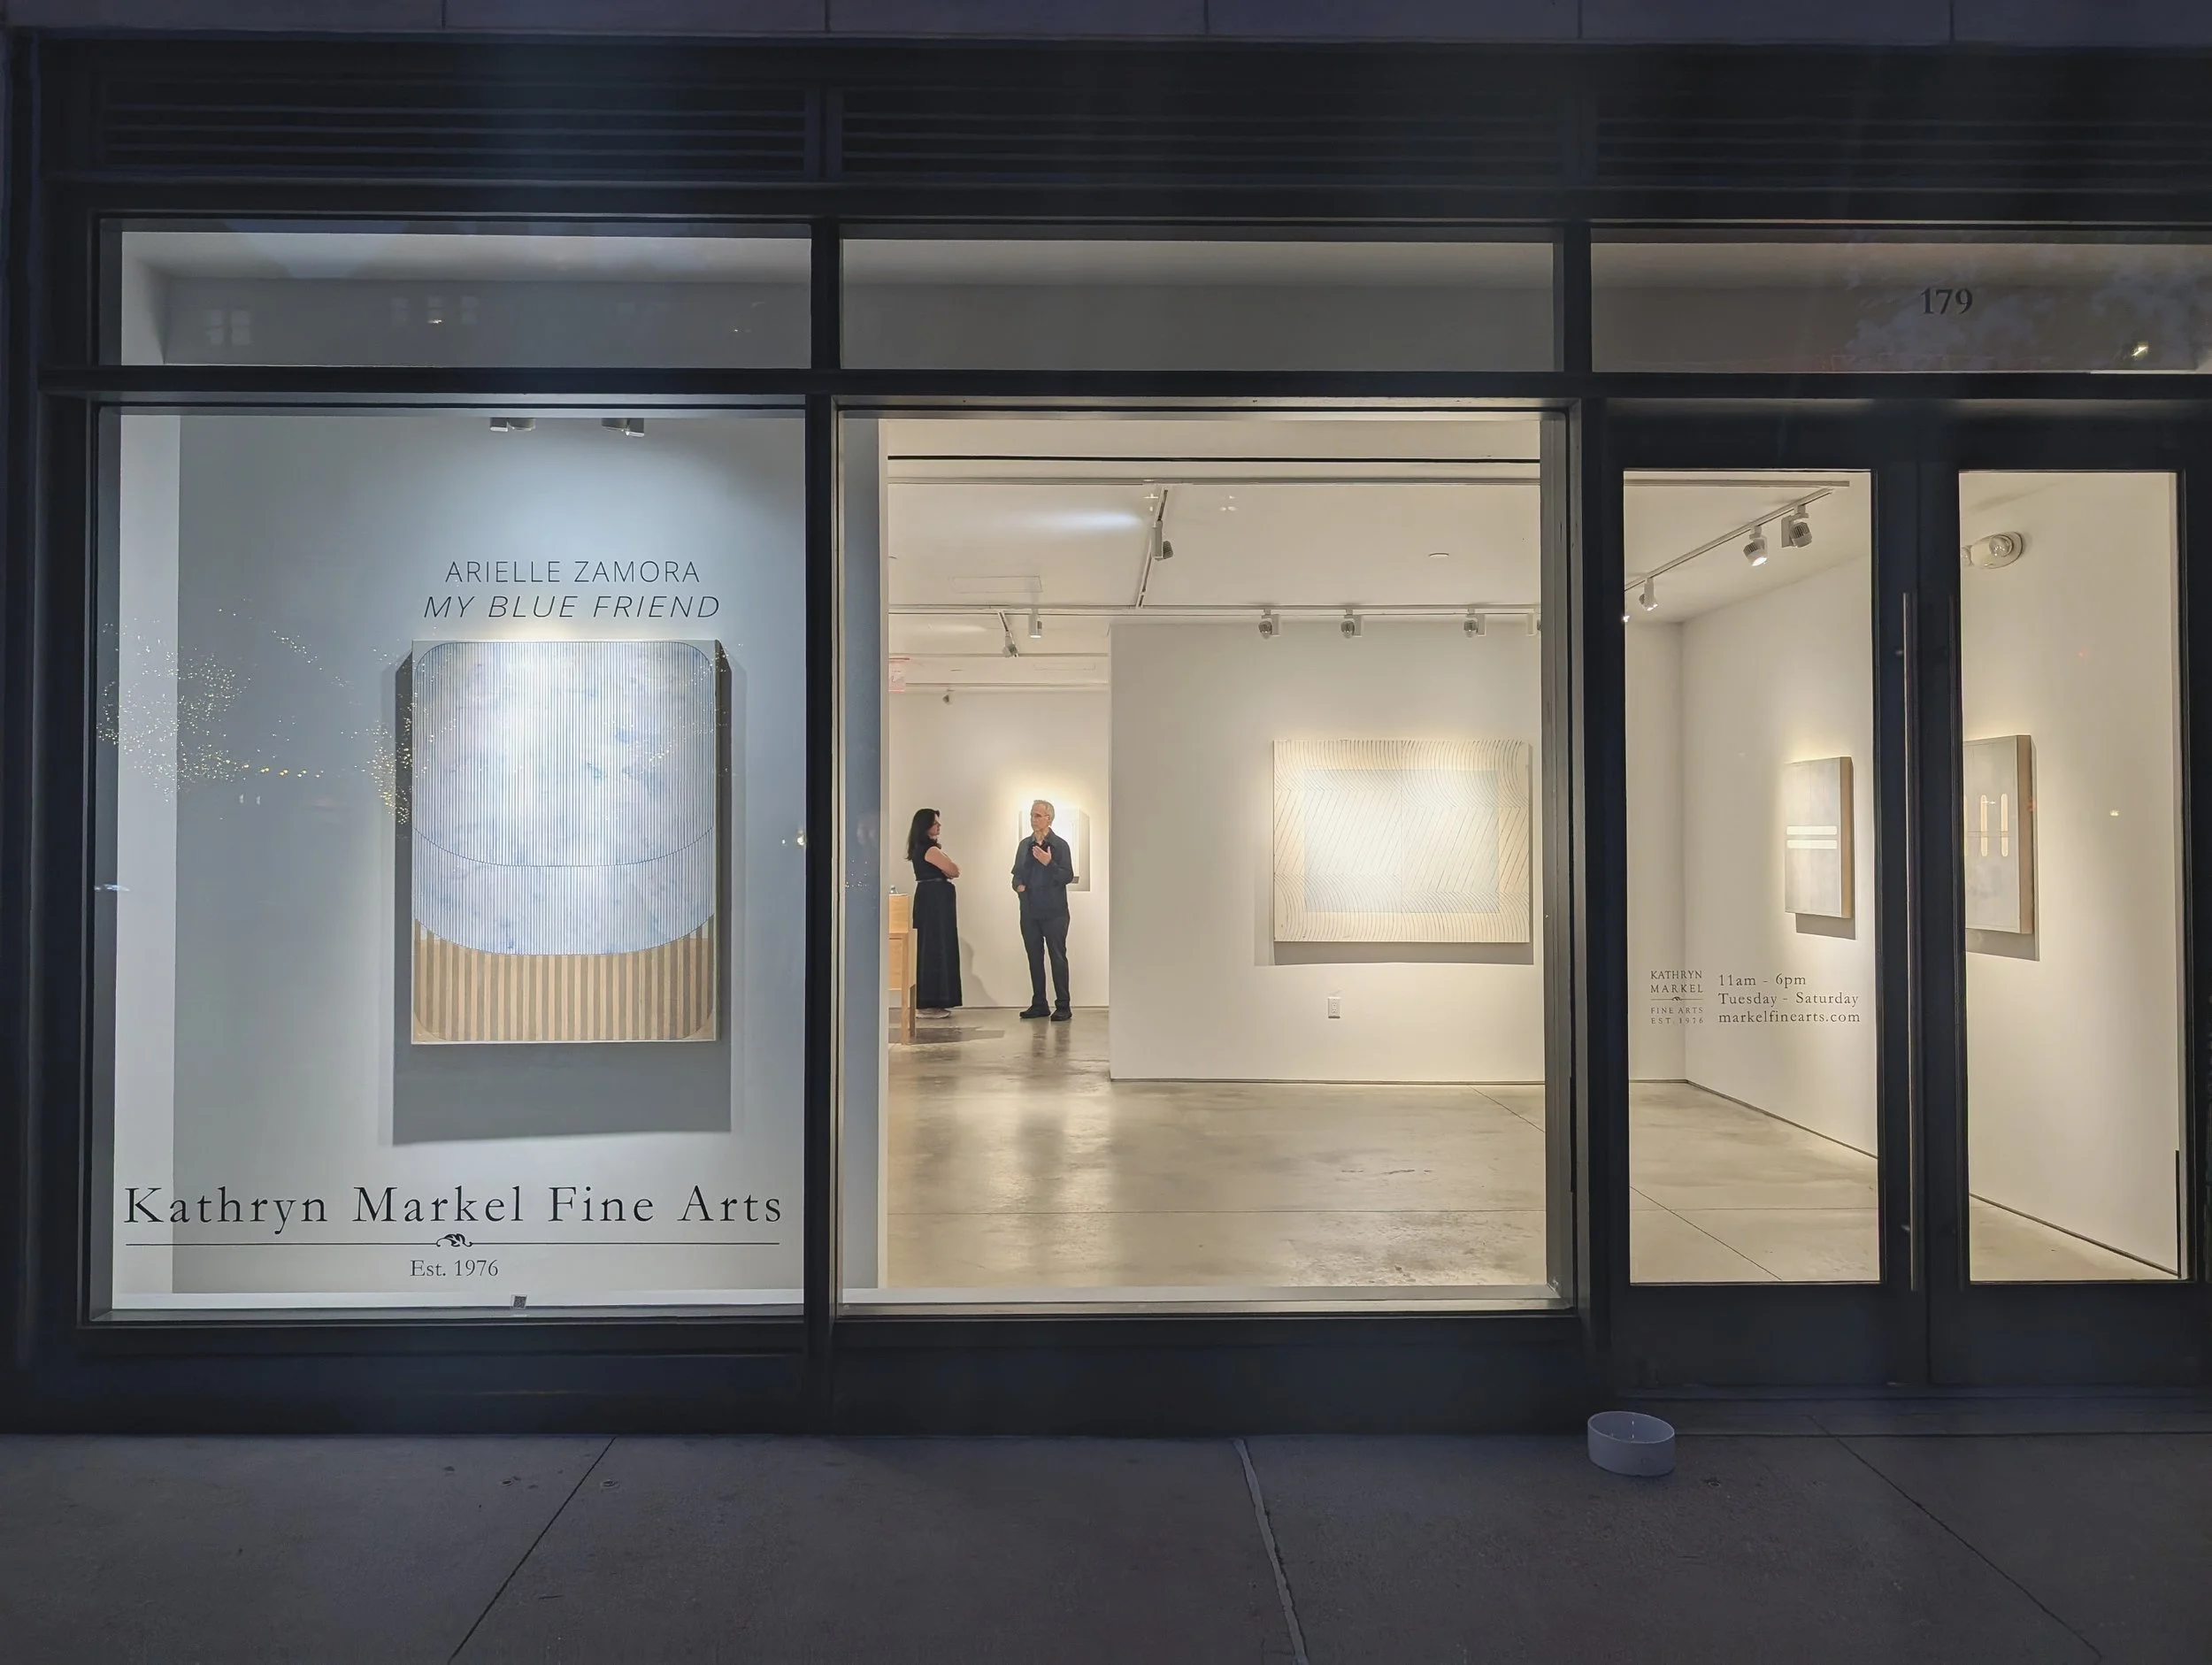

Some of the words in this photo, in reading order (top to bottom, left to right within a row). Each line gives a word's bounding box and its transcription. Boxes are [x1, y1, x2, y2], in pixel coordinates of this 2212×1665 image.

[1921, 287, 1973, 315] 179
[445, 561, 560, 582] ARIELLE
[574, 561, 700, 582] ZAMORA
[424, 595, 475, 618] MY
[488, 595, 578, 618] BLUE
[593, 595, 719, 618] FRIEND
[1650, 971, 1702, 979] KATHRYN
[1719, 974, 1756, 986] 11am
[1775, 973, 1806, 988] 6pm
[1650, 984, 1703, 994] MARKEL
[1718, 993, 1778, 1008] Tuesday
[1795, 992, 1858, 1008] Saturday
[1719, 1010, 1861, 1023] markelfinearts.com
[124, 1186, 328, 1234] Kathryn
[352, 1185, 524, 1224] Markel
[547, 1185, 656, 1223] Fine
[676, 1185, 782, 1223] Arts
[411, 1260, 447, 1278] Est.
[455, 1259, 499, 1278] 1976
